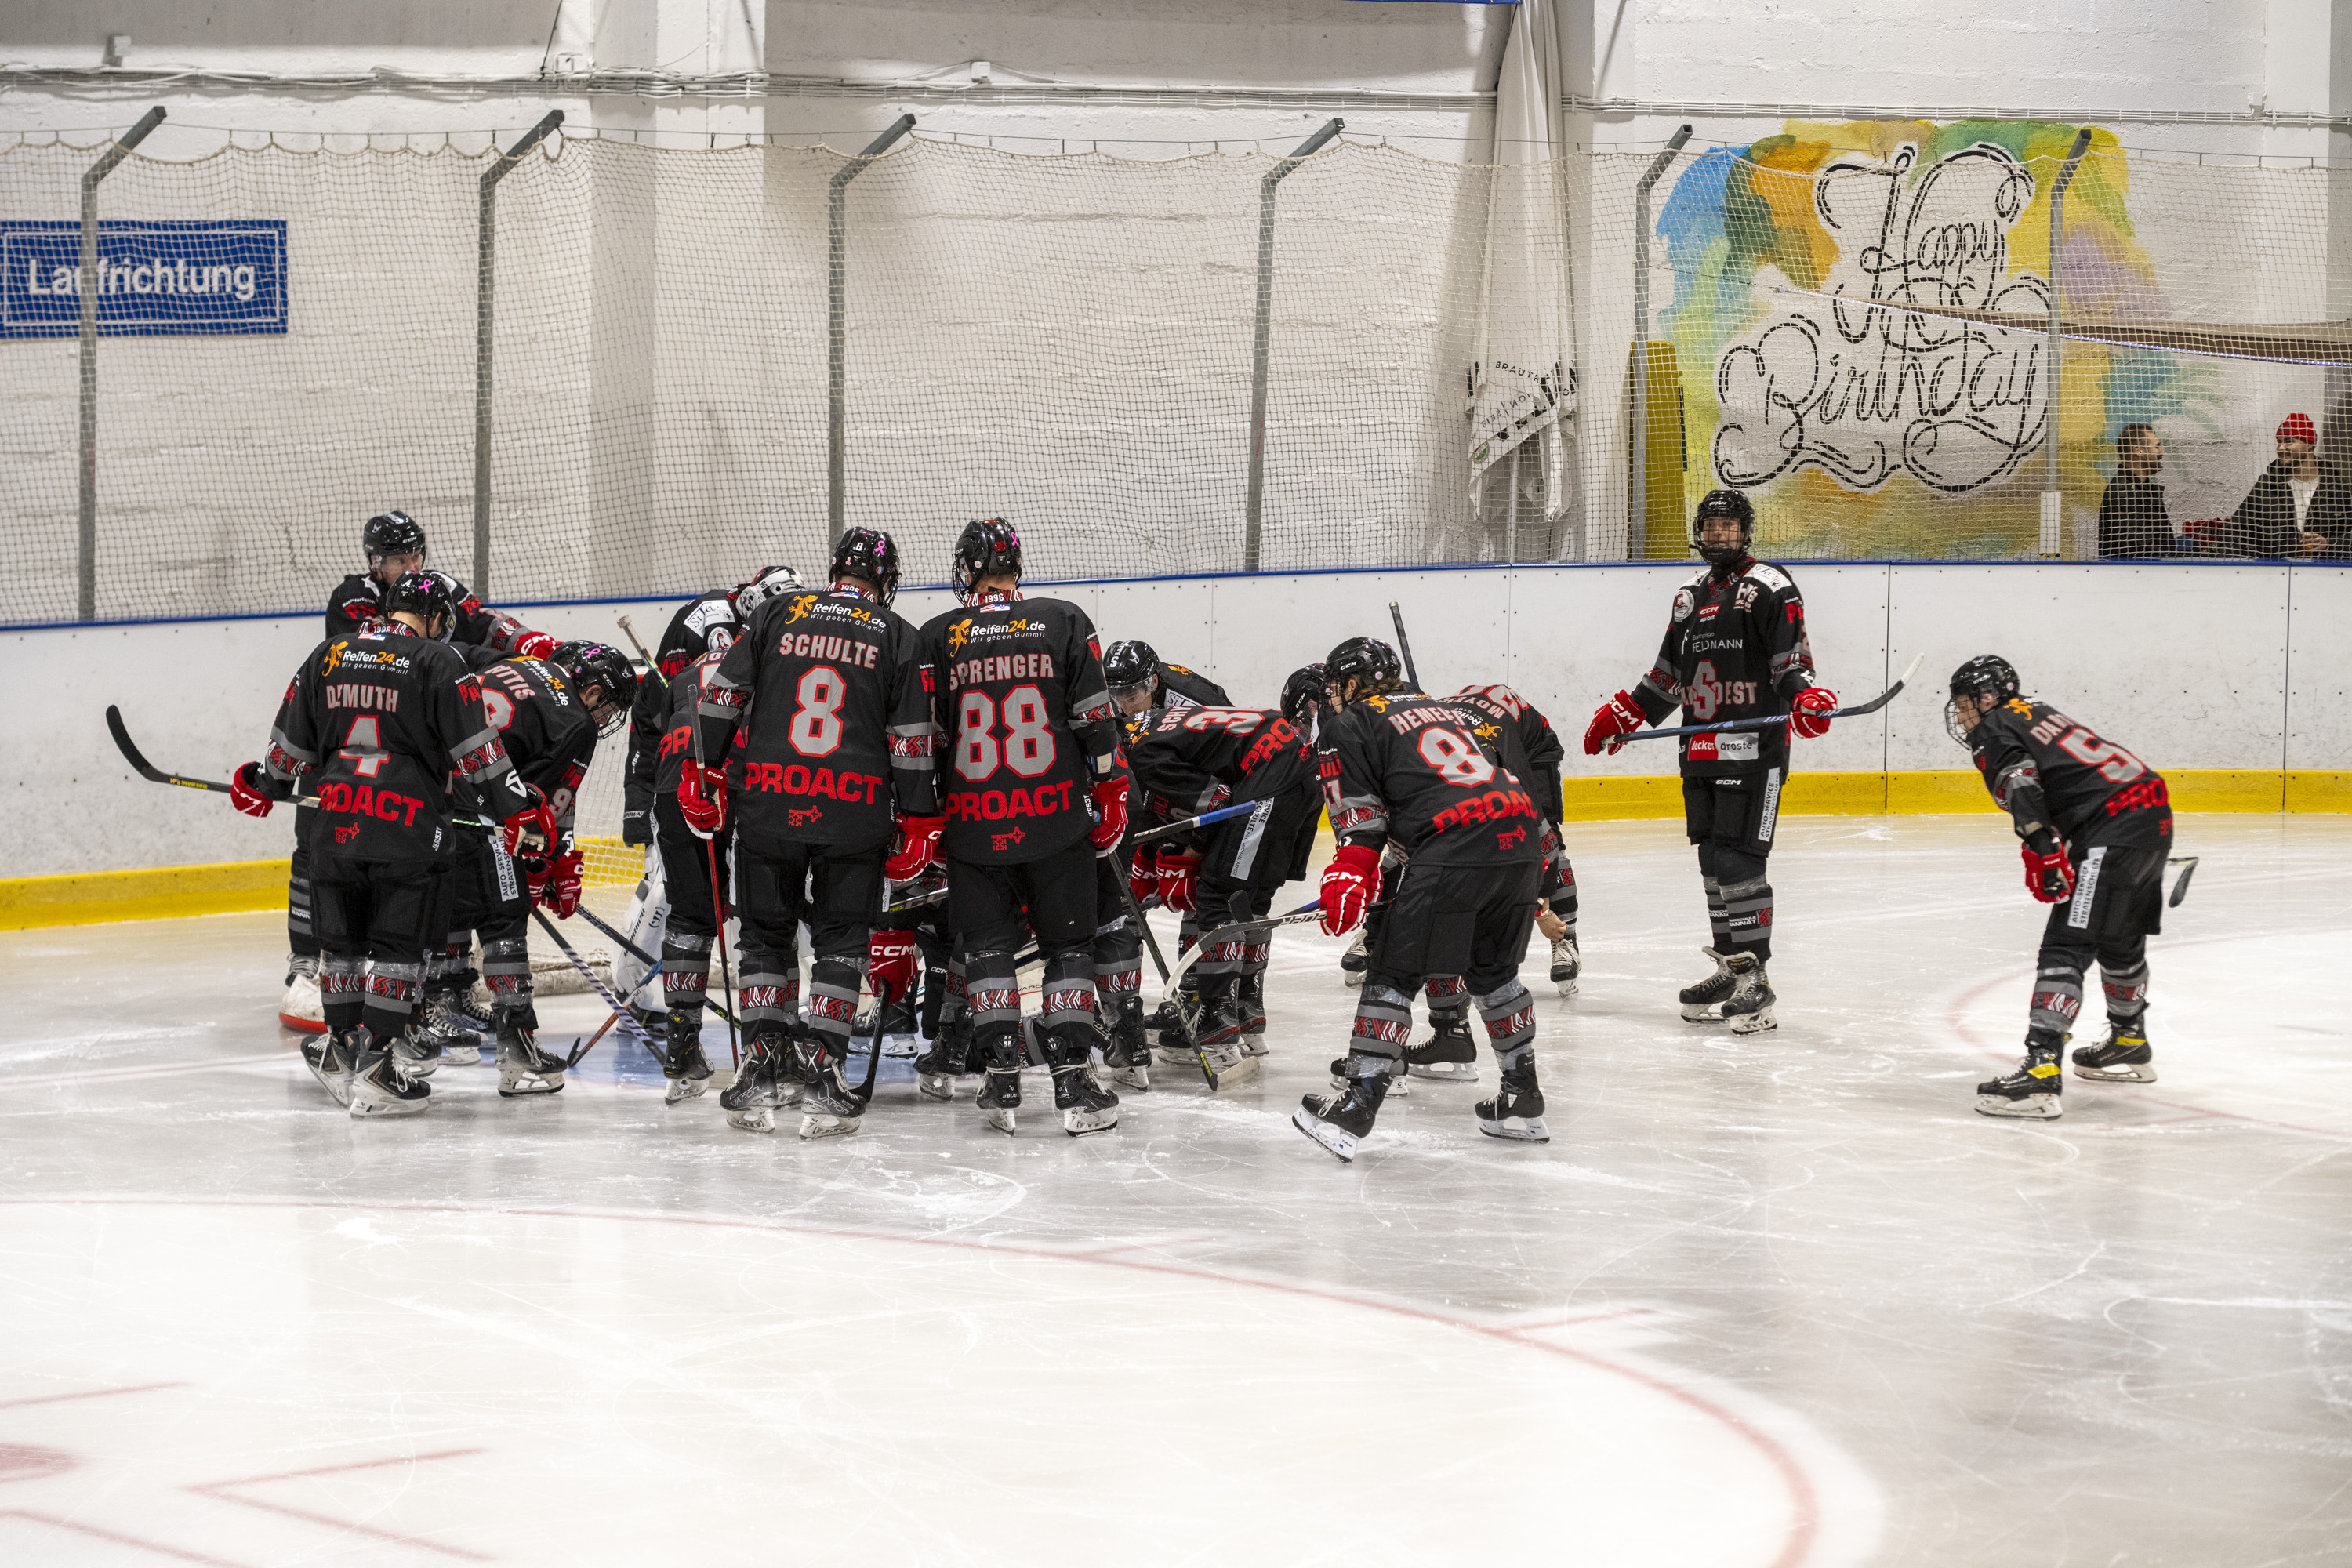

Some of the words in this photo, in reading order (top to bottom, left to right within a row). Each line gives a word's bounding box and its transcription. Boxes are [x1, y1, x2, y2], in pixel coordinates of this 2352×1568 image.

[29, 260, 255, 300] Lafrichtung
[1714, 312, 2049, 489] Birthday
[985, 593, 1004, 603] 1996
[812, 603, 887, 628] Reifen24.de
[826, 615, 851, 624] geben
[1700, 606, 1719, 615] CCM
[971, 619, 1046, 637] Reifen24.de
[986, 633, 1011, 643] geben
[343, 650, 410, 668] Reifen24.de
[779, 633, 879, 670] SCHULTE
[380, 664, 408, 675] Gummi!
[949, 653, 1054, 691] SPRENGER
[1340, 661, 1357, 670] CCM
[1295, 693, 1306, 709] CCM
[788, 665, 847, 758] 8
[955, 684, 1056, 782] 88
[339, 714, 391, 778] 4
[1720, 741, 1753, 750] droste
[707, 771, 724, 780] CCM
[745, 762, 883, 805] PROACT
[946, 779, 1073, 822] PROACT
[1083, 794, 1093, 817] ERS3Y
[1760, 782, 1774, 838] AUTO-SERVICE
[871, 945, 914, 956] CCM
